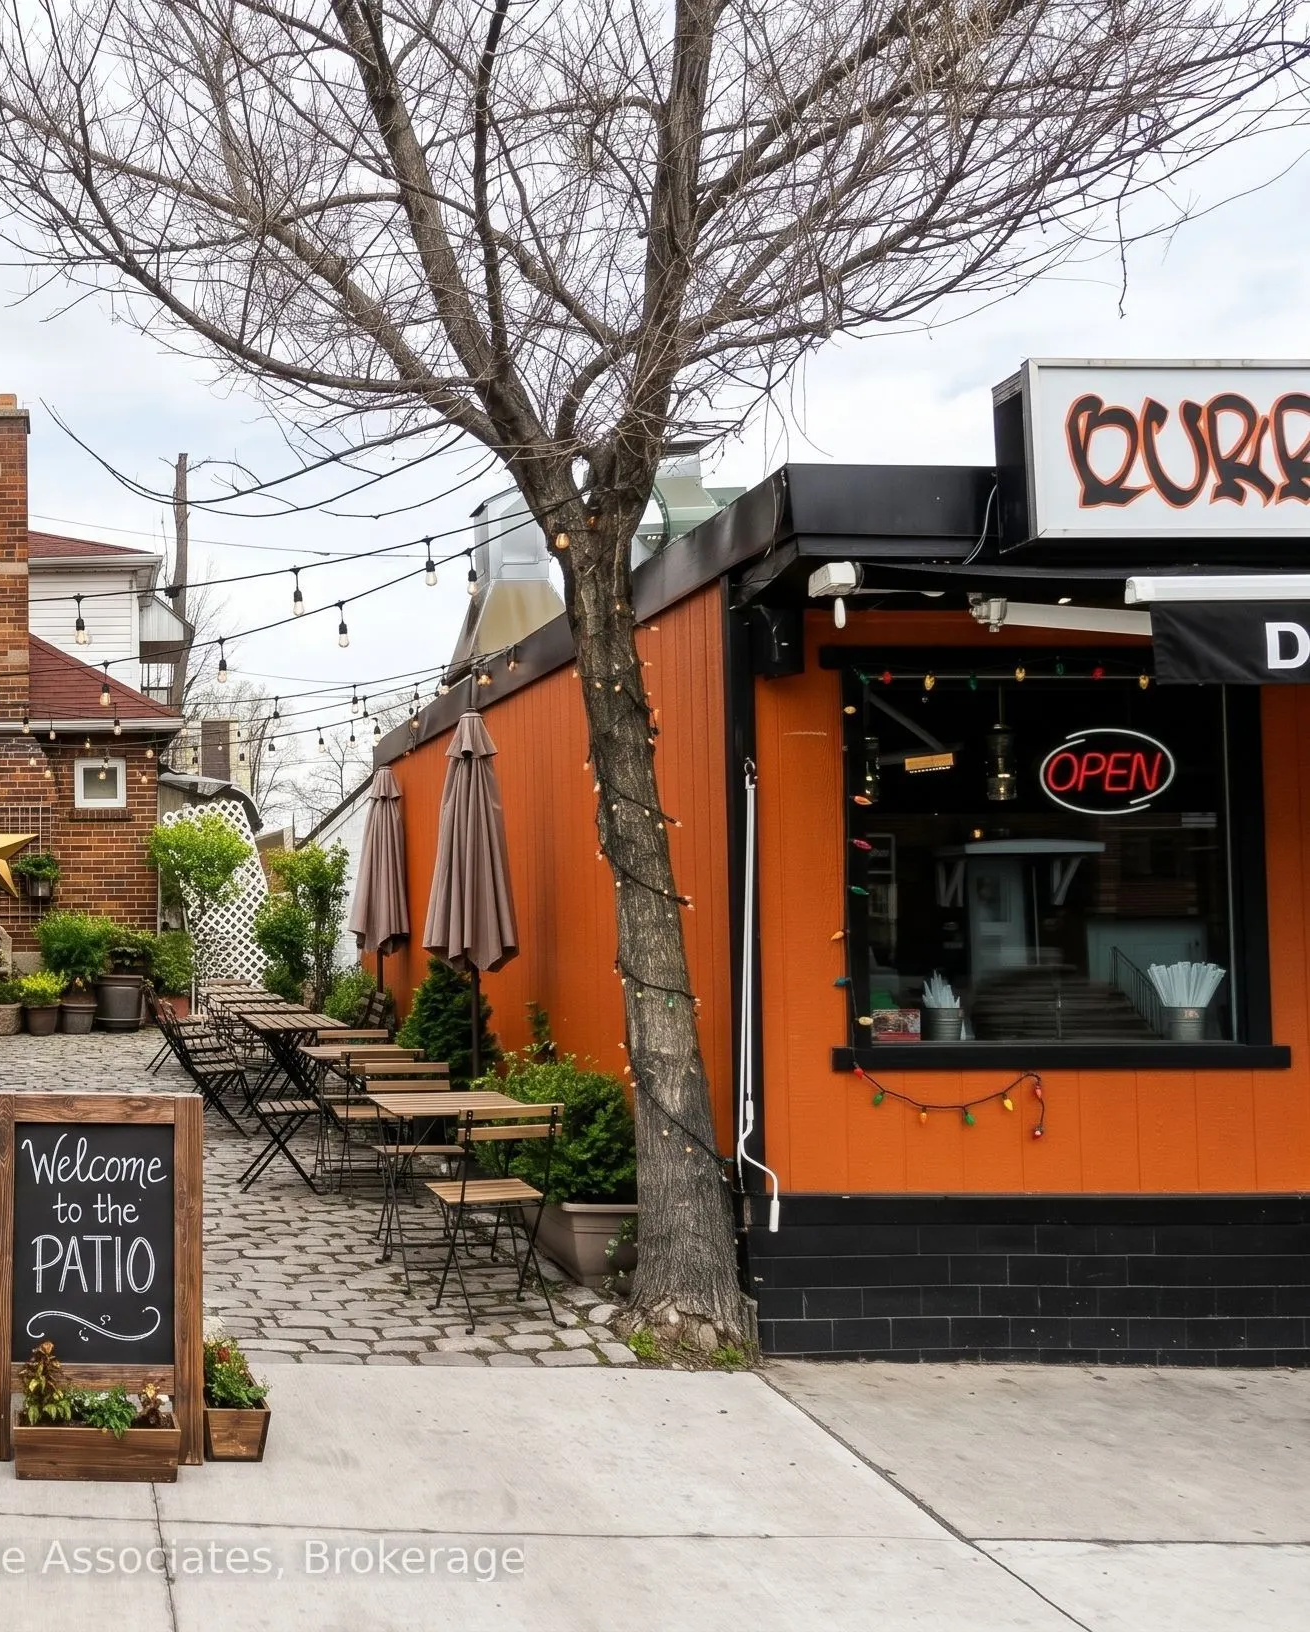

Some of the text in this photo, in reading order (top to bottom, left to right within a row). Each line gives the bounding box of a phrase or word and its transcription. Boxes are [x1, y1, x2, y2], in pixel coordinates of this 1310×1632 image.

[1047, 752, 1162, 792] OPEN
[21, 1133, 168, 1190] Welcome
[52, 1193, 140, 1226] to the
[31, 1234, 156, 1294] PATIO
